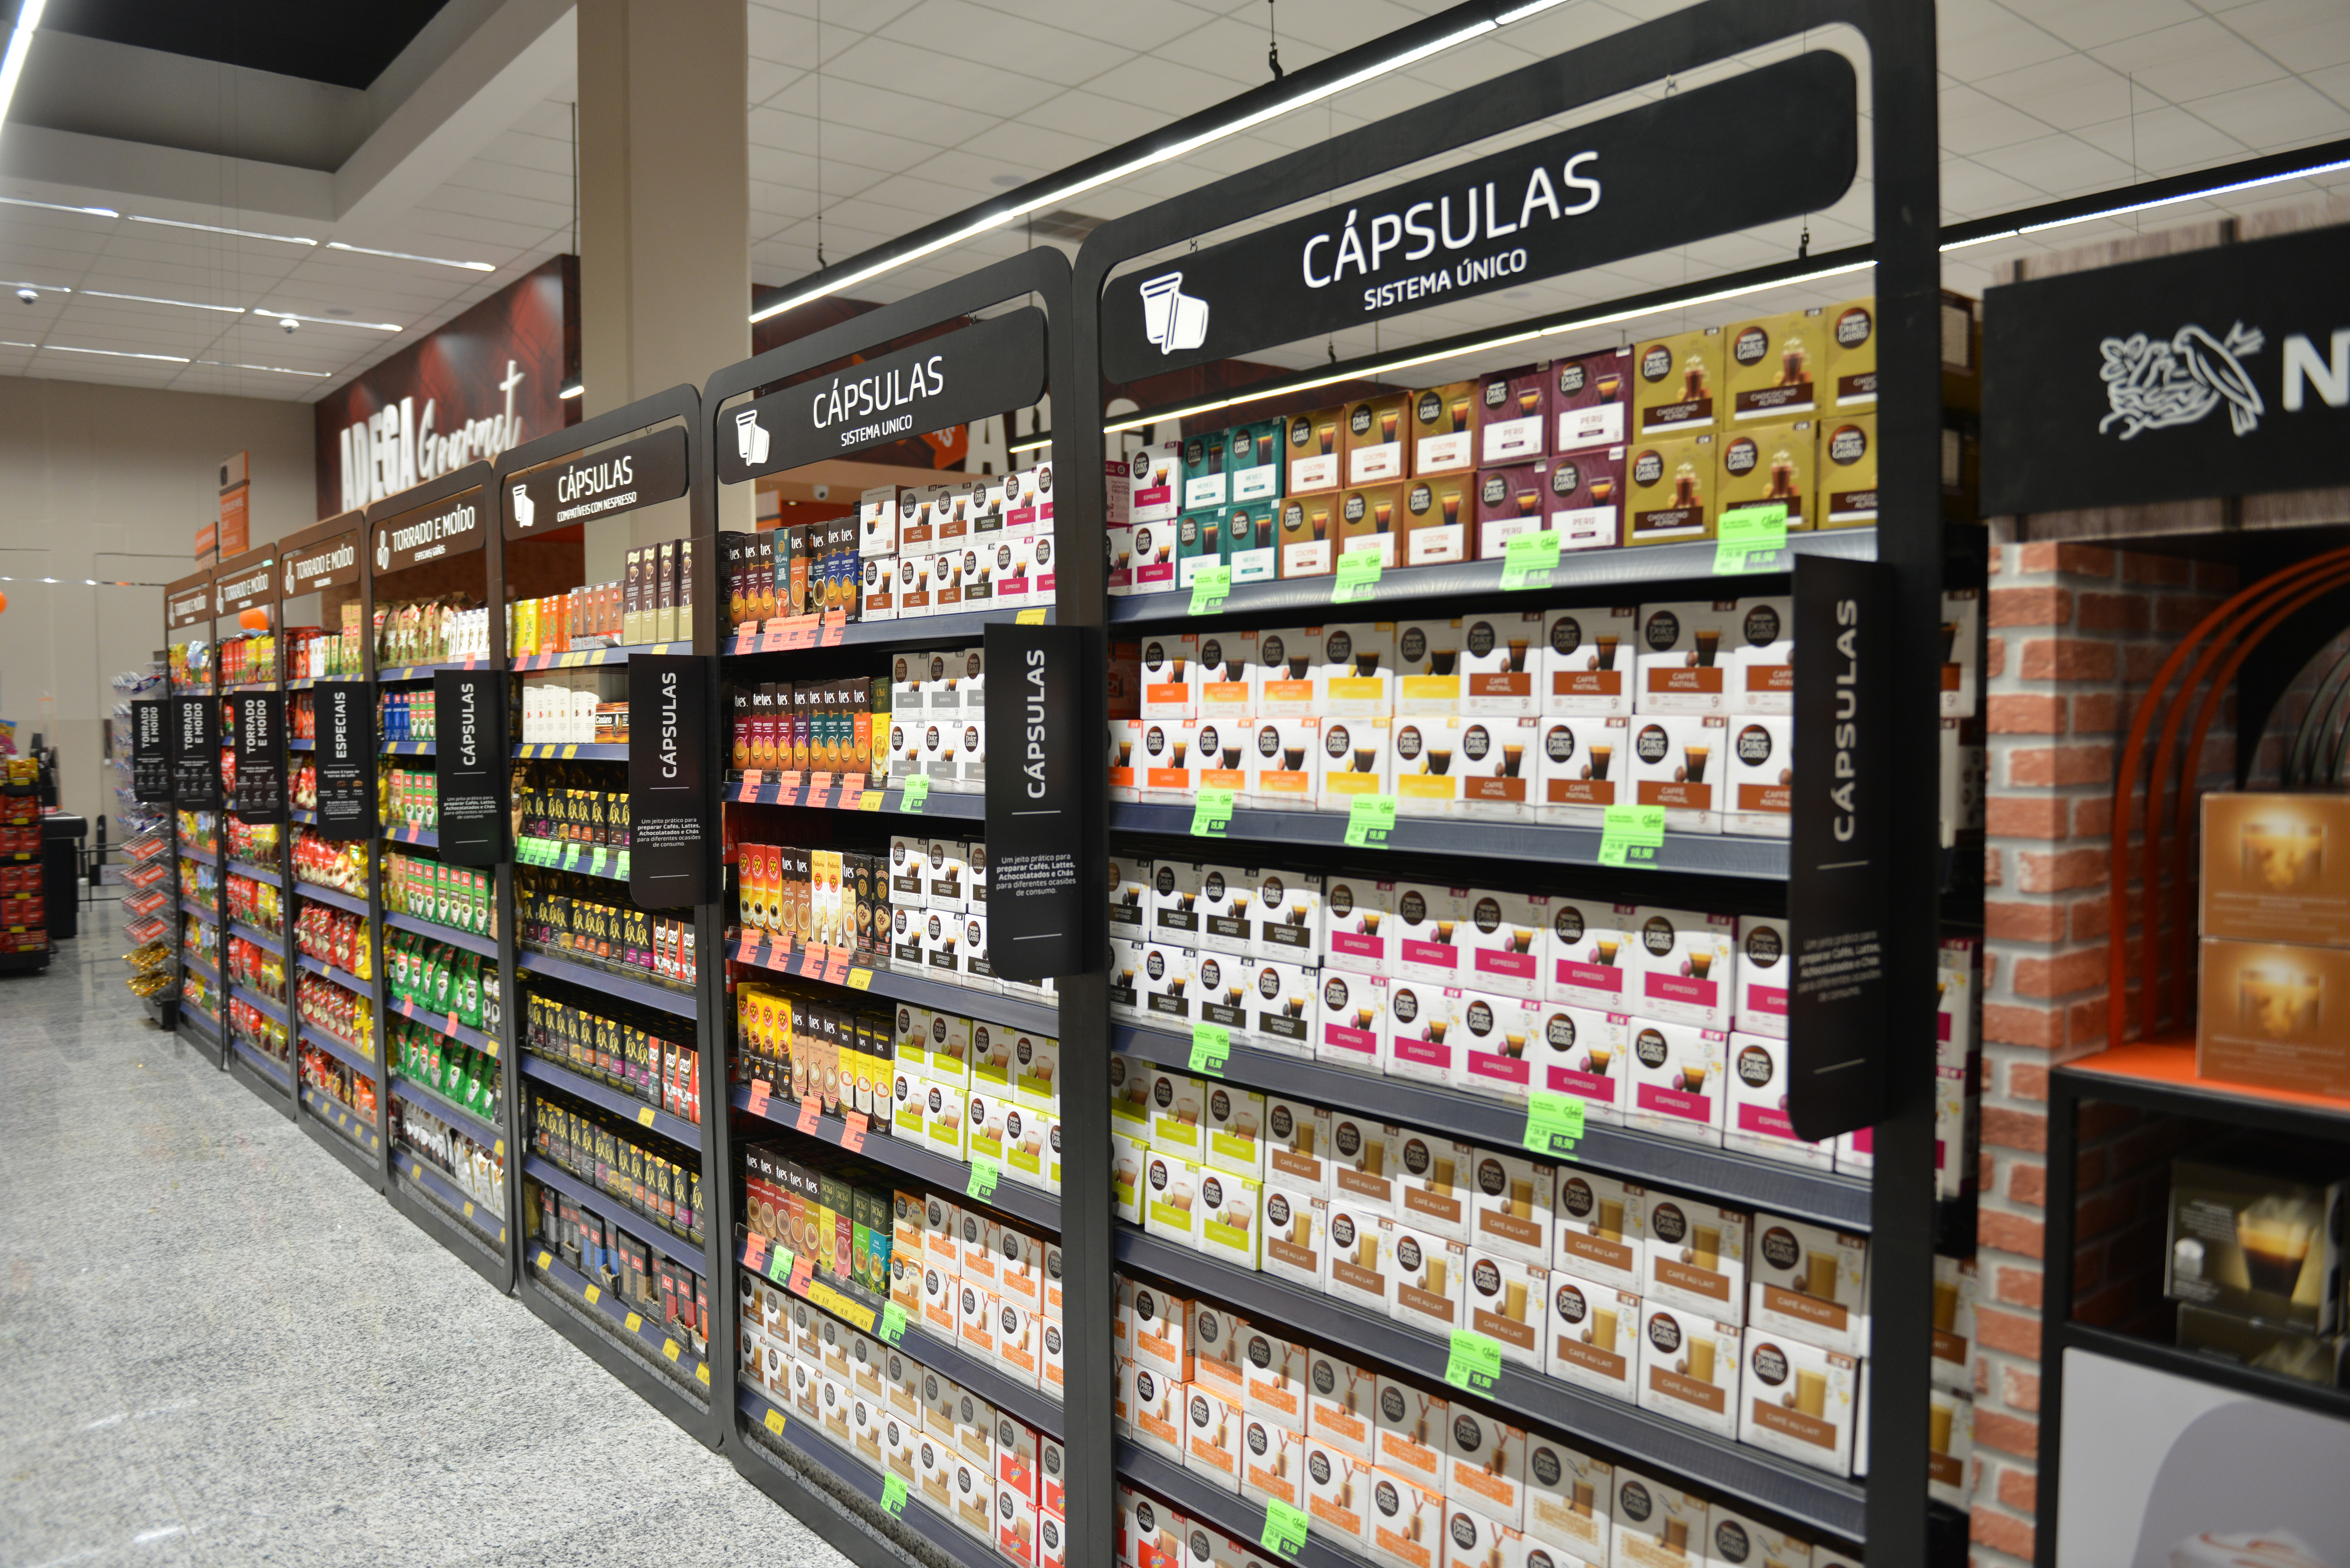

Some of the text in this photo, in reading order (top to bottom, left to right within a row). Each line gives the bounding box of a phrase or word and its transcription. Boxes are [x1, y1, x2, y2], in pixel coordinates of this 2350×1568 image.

[1302, 151, 1602, 289] CÁPSULAS
[1364, 248, 1528, 312] SISTEMA ÚNICO
[813, 356, 943, 429] CÁPSULAS
[340, 359, 525, 513] ADEGA Gourmet
[841, 415, 912, 447] SISTEMA UNICO
[558, 455, 633, 503] CÁPSULAS
[557, 491, 637, 523] COMPATÍVEIS COM NESPRESSO
[392, 504, 476, 552] TORRADO E MOÍDO
[841, 528, 854, 542] tres.
[296, 543, 354, 580] TORRADO E MOÍDO
[760, 543, 773, 555] tres.
[224, 571, 268, 602] TORRADO E MOÍDO
[854, 690, 867, 703] tres.
[141, 707, 150, 748] TORRADO
[150, 707, 159, 735] MOÍDO
[184, 703, 193, 750] TORRADO
[193, 703, 203, 735] MOÍDO
[245, 700, 256, 754] TORRADO
[256, 700, 267, 736] MOÍDO
[335, 692, 347, 758] ESPECIAIS
[461, 683, 476, 765] CÁPSULAS
[596, 715, 612, 724] Cassiano
[660, 672, 677, 778] CÁPSULAS
[1024, 649, 1045, 798] CÁPSULAS
[1830, 600, 1858, 842] CÁPSULAS
[782, 857, 794, 870] tres.
[843, 864, 854, 878] tres
[996, 865, 1027, 874] preparar
[1031, 854, 1054, 863] prático
[999, 871, 1050, 881] Achocolatados
[809, 1014, 821, 1030] tres.
[806, 1178, 819, 1194] tres.
[981, 1187, 991, 1196] 19,90
[872, 1205, 883, 1217] 3Chá
[1003, 1319, 1015, 1330] Gusto
[1004, 1314, 1015, 1325] Dolce
[892, 1331, 901, 1341] 19,90
[1008, 1348, 1027, 1361] MOCHACCINO
